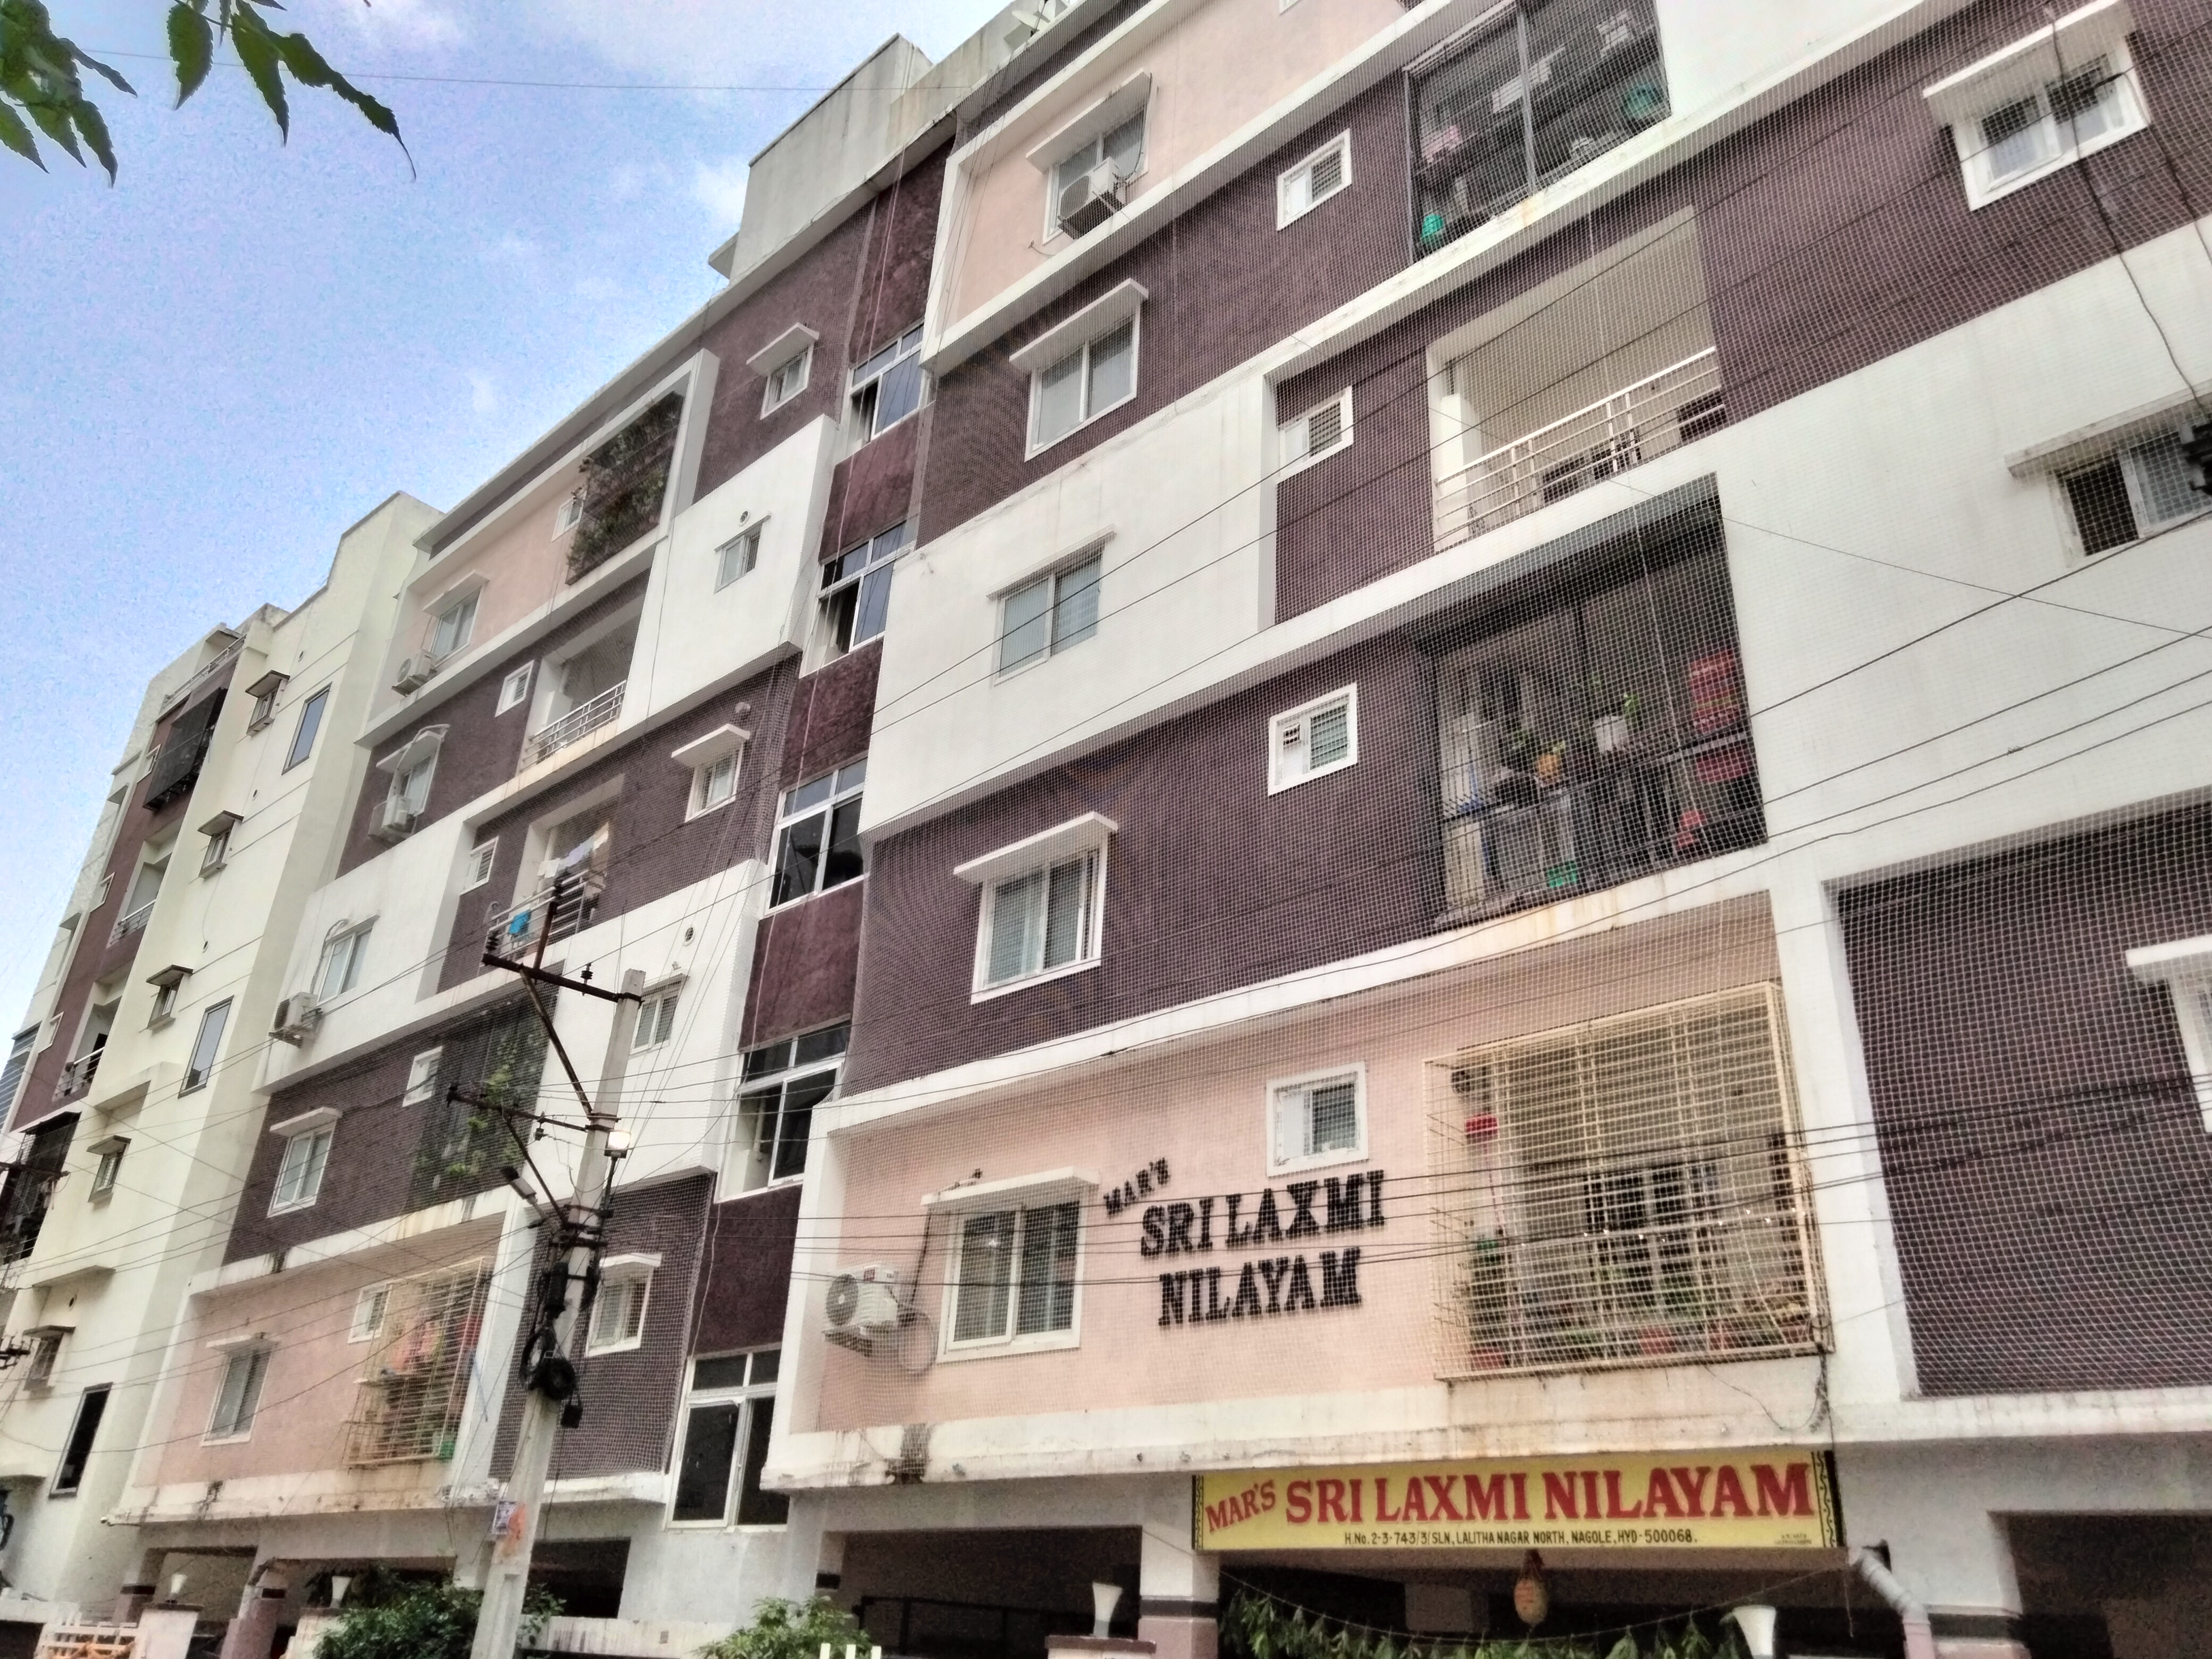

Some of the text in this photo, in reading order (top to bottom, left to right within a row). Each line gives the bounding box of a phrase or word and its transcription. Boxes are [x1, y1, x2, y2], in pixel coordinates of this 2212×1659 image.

[1141, 1170, 1385, 1256] SRI LAXMI
[1158, 1247, 1362, 1326] NILAYAM
[1205, 1479, 1276, 1534] MAR'S
[1286, 1463, 1815, 1524] SRI LAXMI NILAYAM
[1456, 1531, 1495, 1544] LALITHA
[1497, 1530, 1530, 1544] NAGAR
